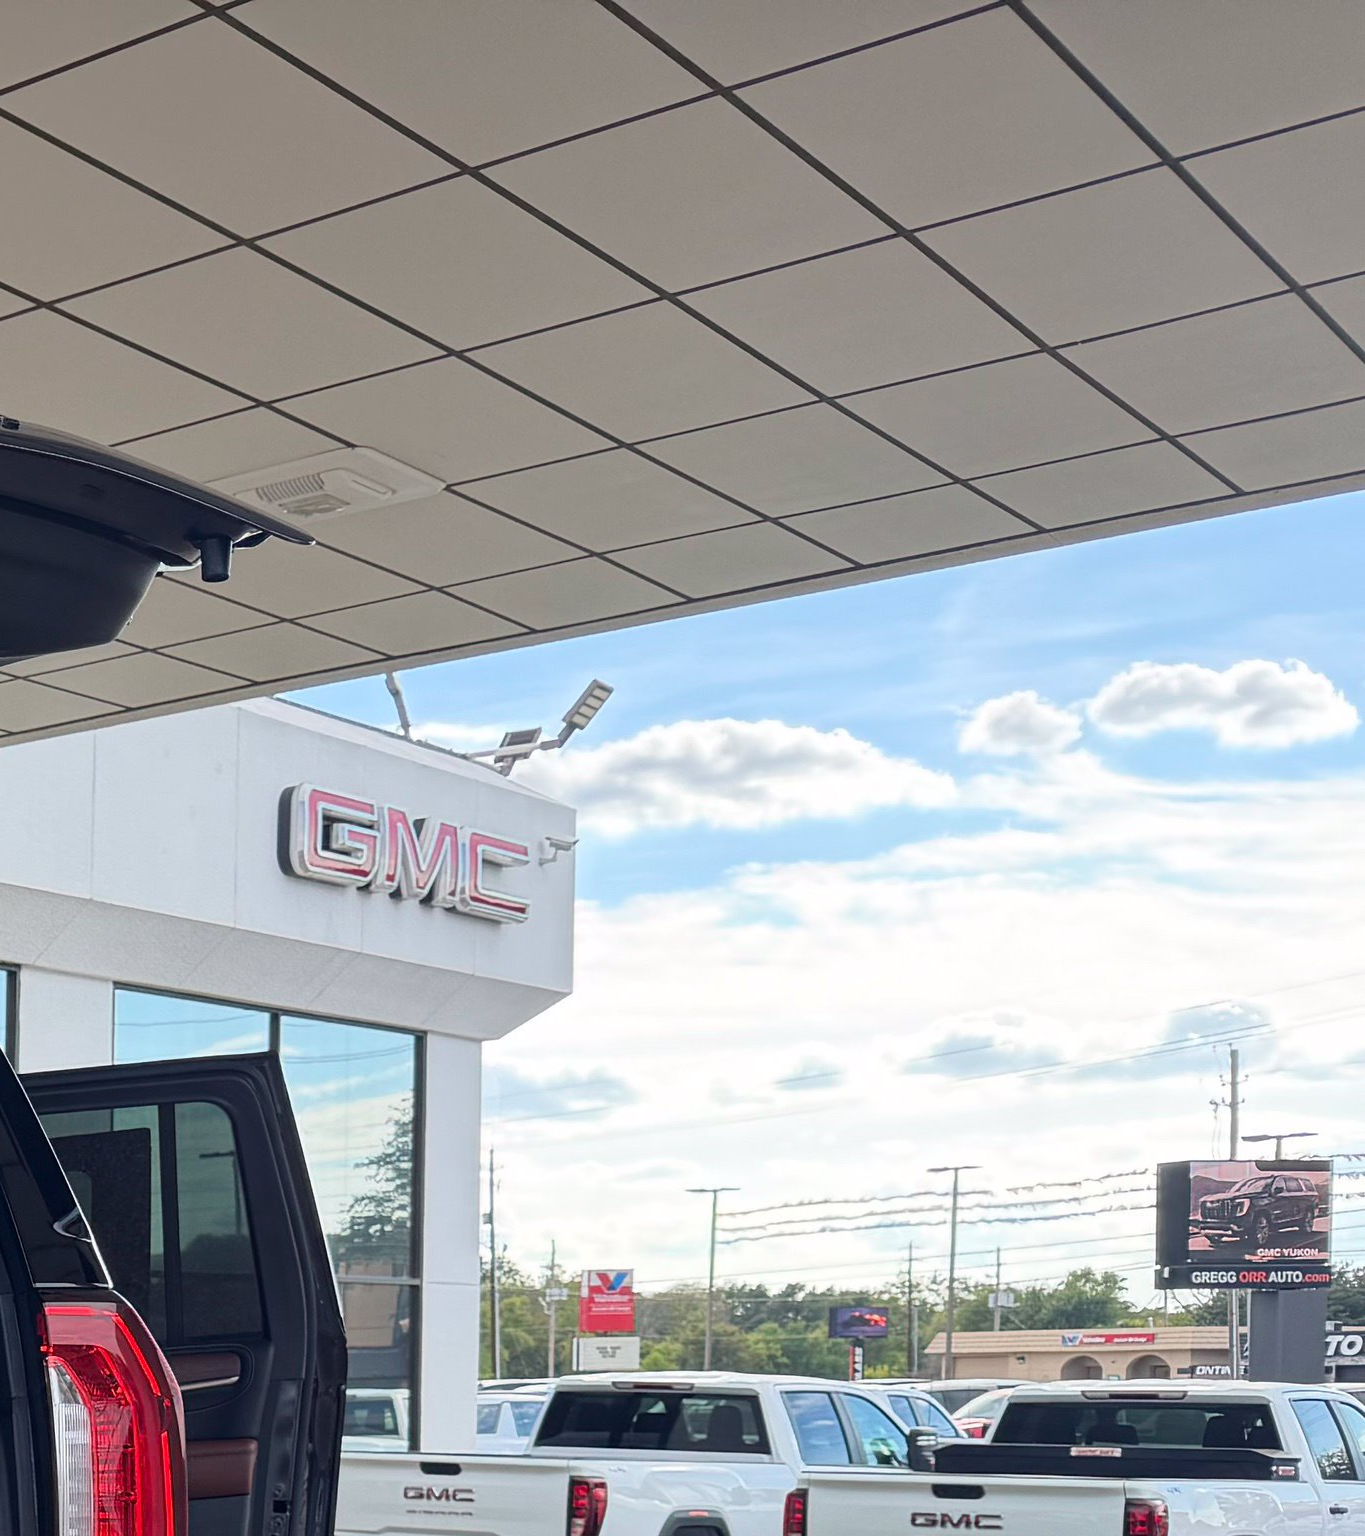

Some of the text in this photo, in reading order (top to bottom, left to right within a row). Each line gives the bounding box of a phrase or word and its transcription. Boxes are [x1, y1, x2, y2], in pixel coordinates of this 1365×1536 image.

[289, 783, 531, 922] GMC
[1257, 1248, 1319, 1257] GMC YUKON
[1191, 1271, 1329, 1283] GREGG ORR AUTO.com
[403, 1486, 475, 1502] GMC
[910, 1511, 1004, 1530] GMC
